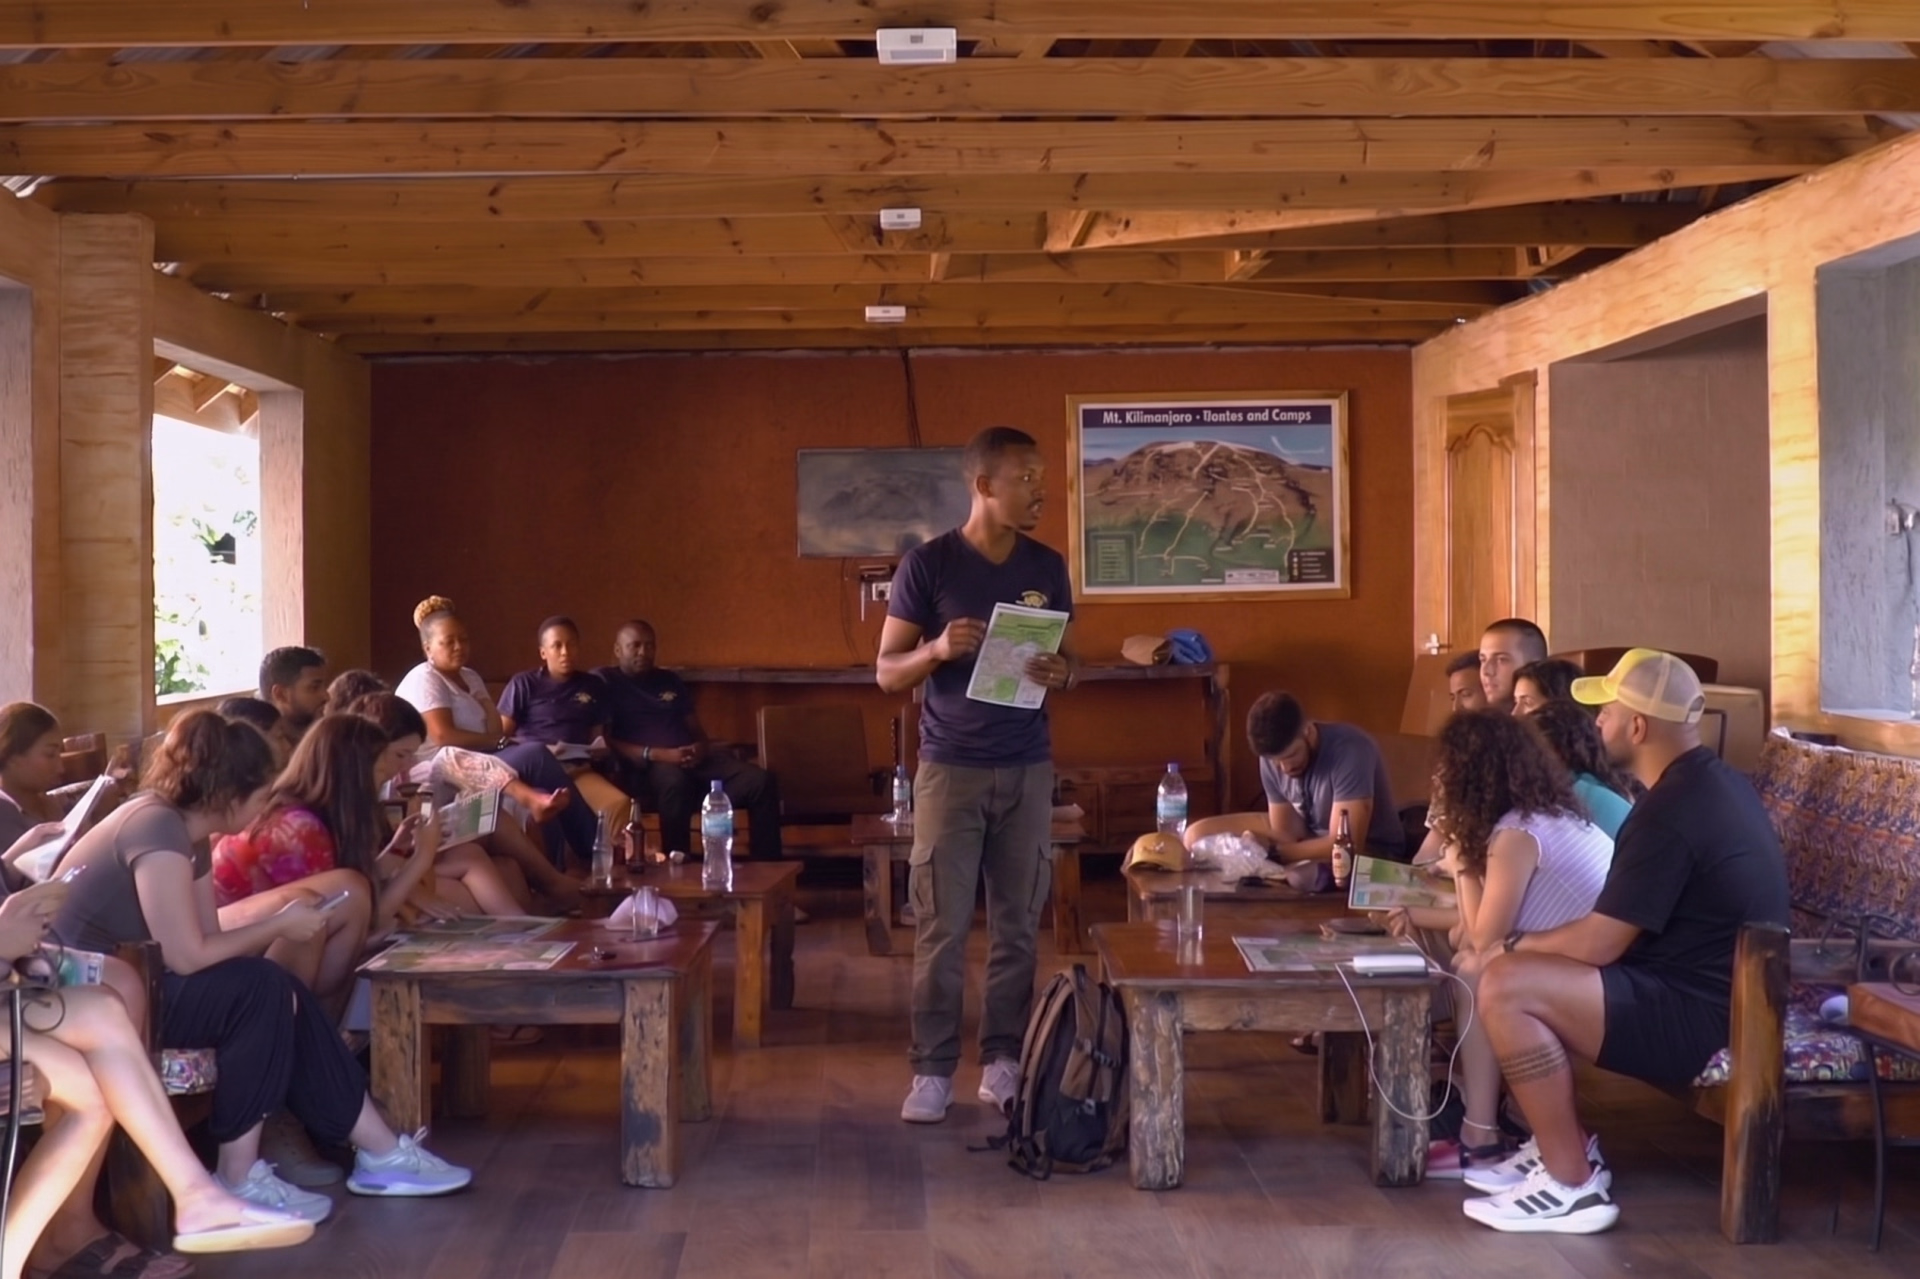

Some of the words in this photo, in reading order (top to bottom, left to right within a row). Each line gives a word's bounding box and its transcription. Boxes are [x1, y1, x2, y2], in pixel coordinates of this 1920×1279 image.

[1103, 411, 1122, 424] Mt.
[1246, 408, 1269, 422] and
[1272, 408, 1311, 424] Camps
